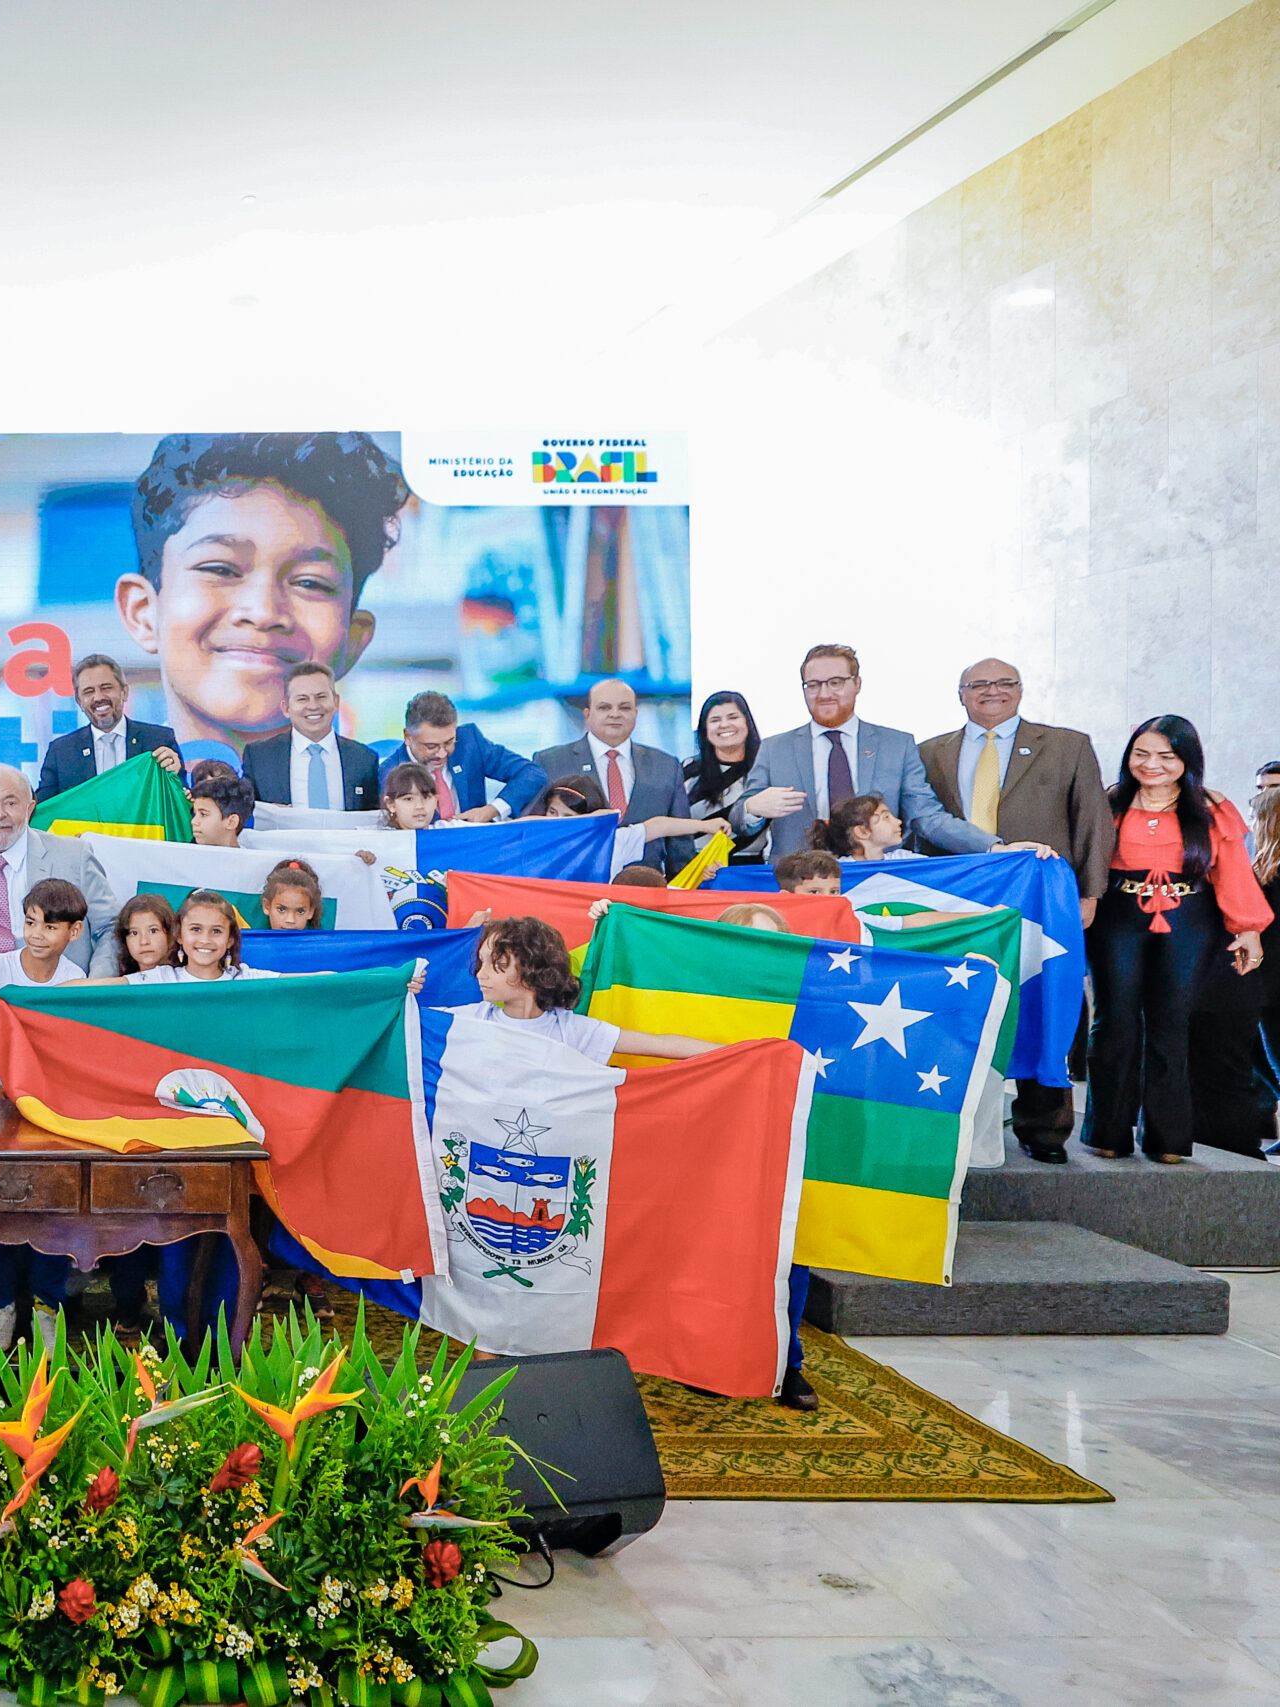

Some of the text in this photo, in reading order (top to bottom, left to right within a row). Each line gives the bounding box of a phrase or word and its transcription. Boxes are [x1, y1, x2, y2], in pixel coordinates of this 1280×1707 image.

[542, 439, 647, 447] GOVERNO FEDERAL
[428, 457, 513, 465] MINISTÉRIO DA
[532, 451, 658, 482] BRASIL
[453, 468, 513, 478] EDUCAÇÃO
